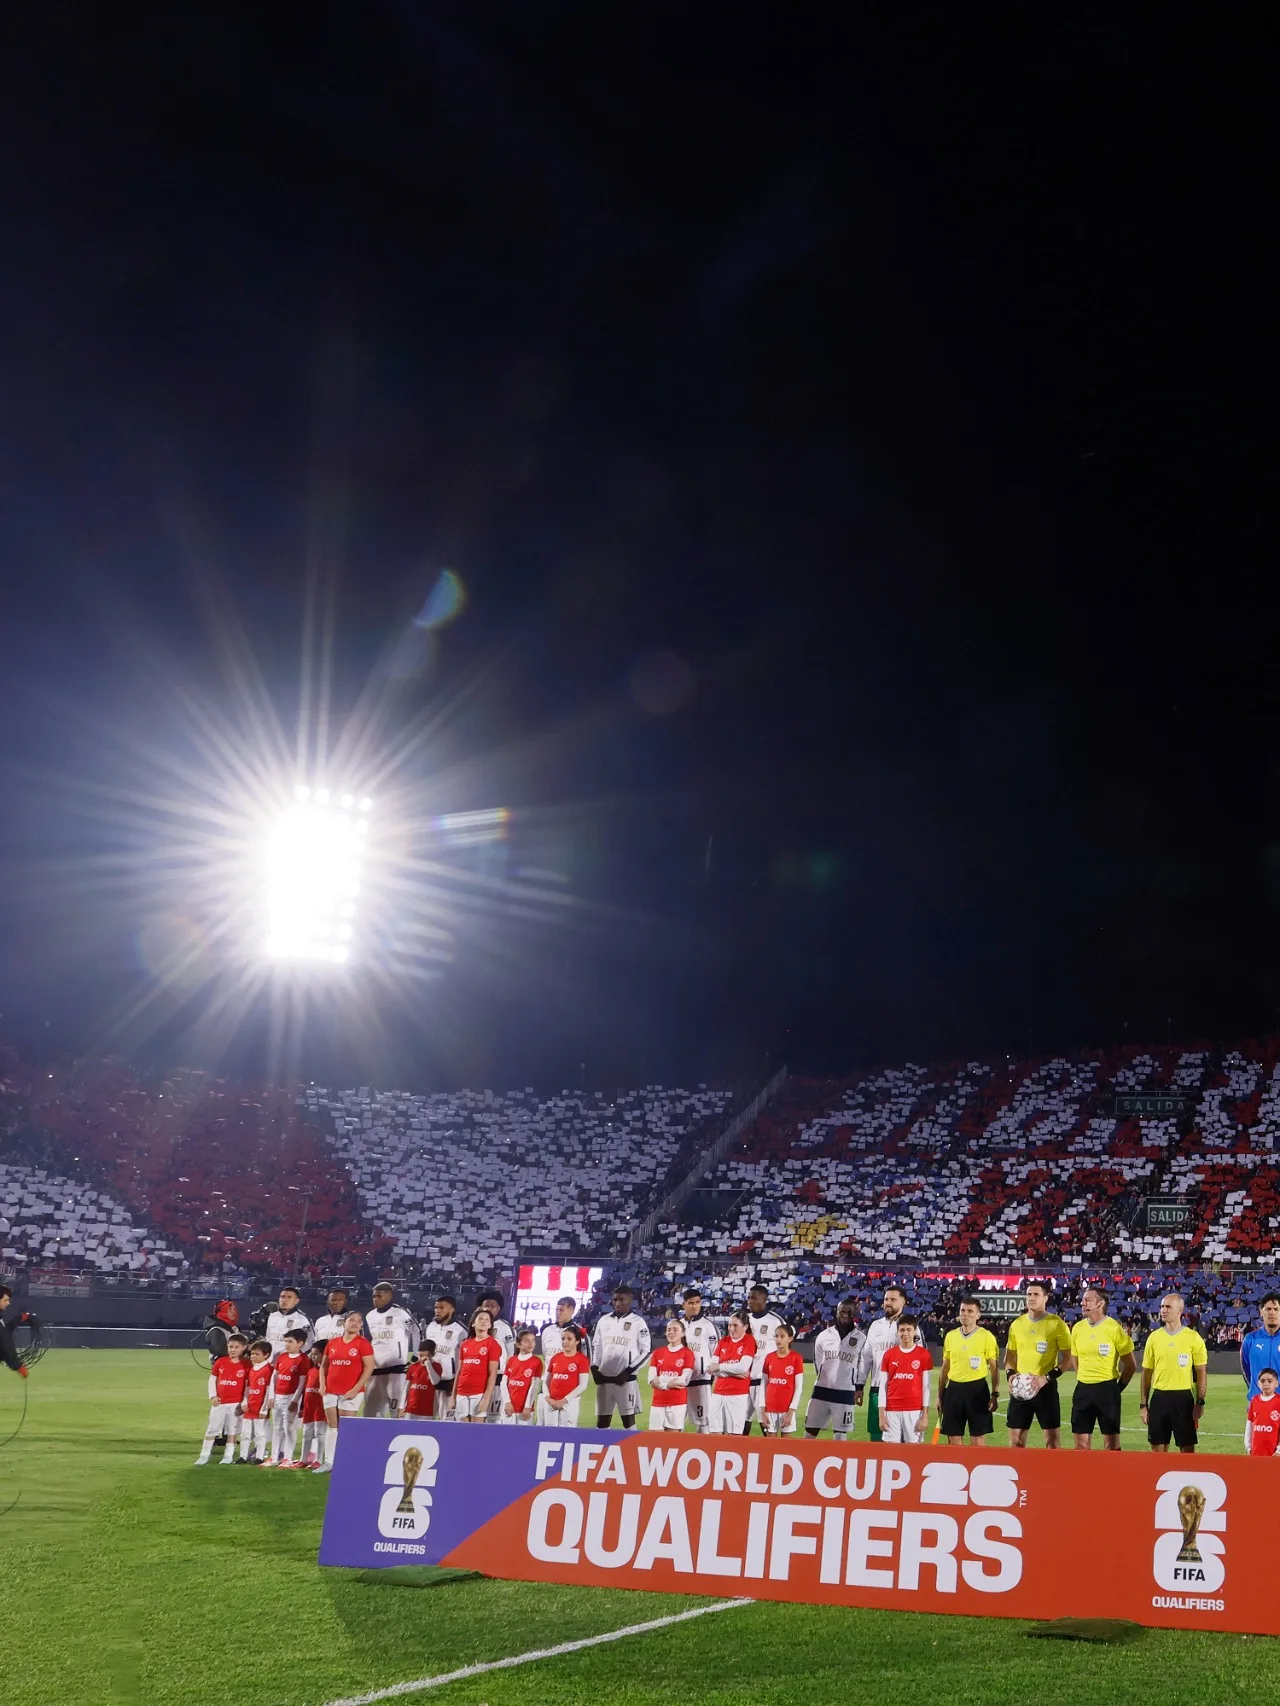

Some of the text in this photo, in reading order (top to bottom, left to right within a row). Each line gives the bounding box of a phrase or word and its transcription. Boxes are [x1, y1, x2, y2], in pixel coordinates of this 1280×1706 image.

[1123, 1101, 1185, 1112] SALIDA
[1150, 1210, 1190, 1222] SALIDA
[980, 1299, 1025, 1312] SALIDA
[824, 1350, 856, 1364] ECUADOR
[696, 1406, 704, 1417] 3
[843, 1411, 853, 1424] 13
[535, 1441, 627, 1484] FIFA
[637, 1446, 804, 1495] WORLD
[813, 1456, 911, 1501] CUP
[920, 1462, 1019, 1507] 26
[392, 1518, 415, 1529] FIFA
[526, 1488, 1022, 1593] QUALIFIERS
[374, 1542, 426, 1554] QUALIFIERS
[1173, 1568, 1205, 1581] FIFA
[1152, 1596, 1225, 1611] QUALIFIERS
